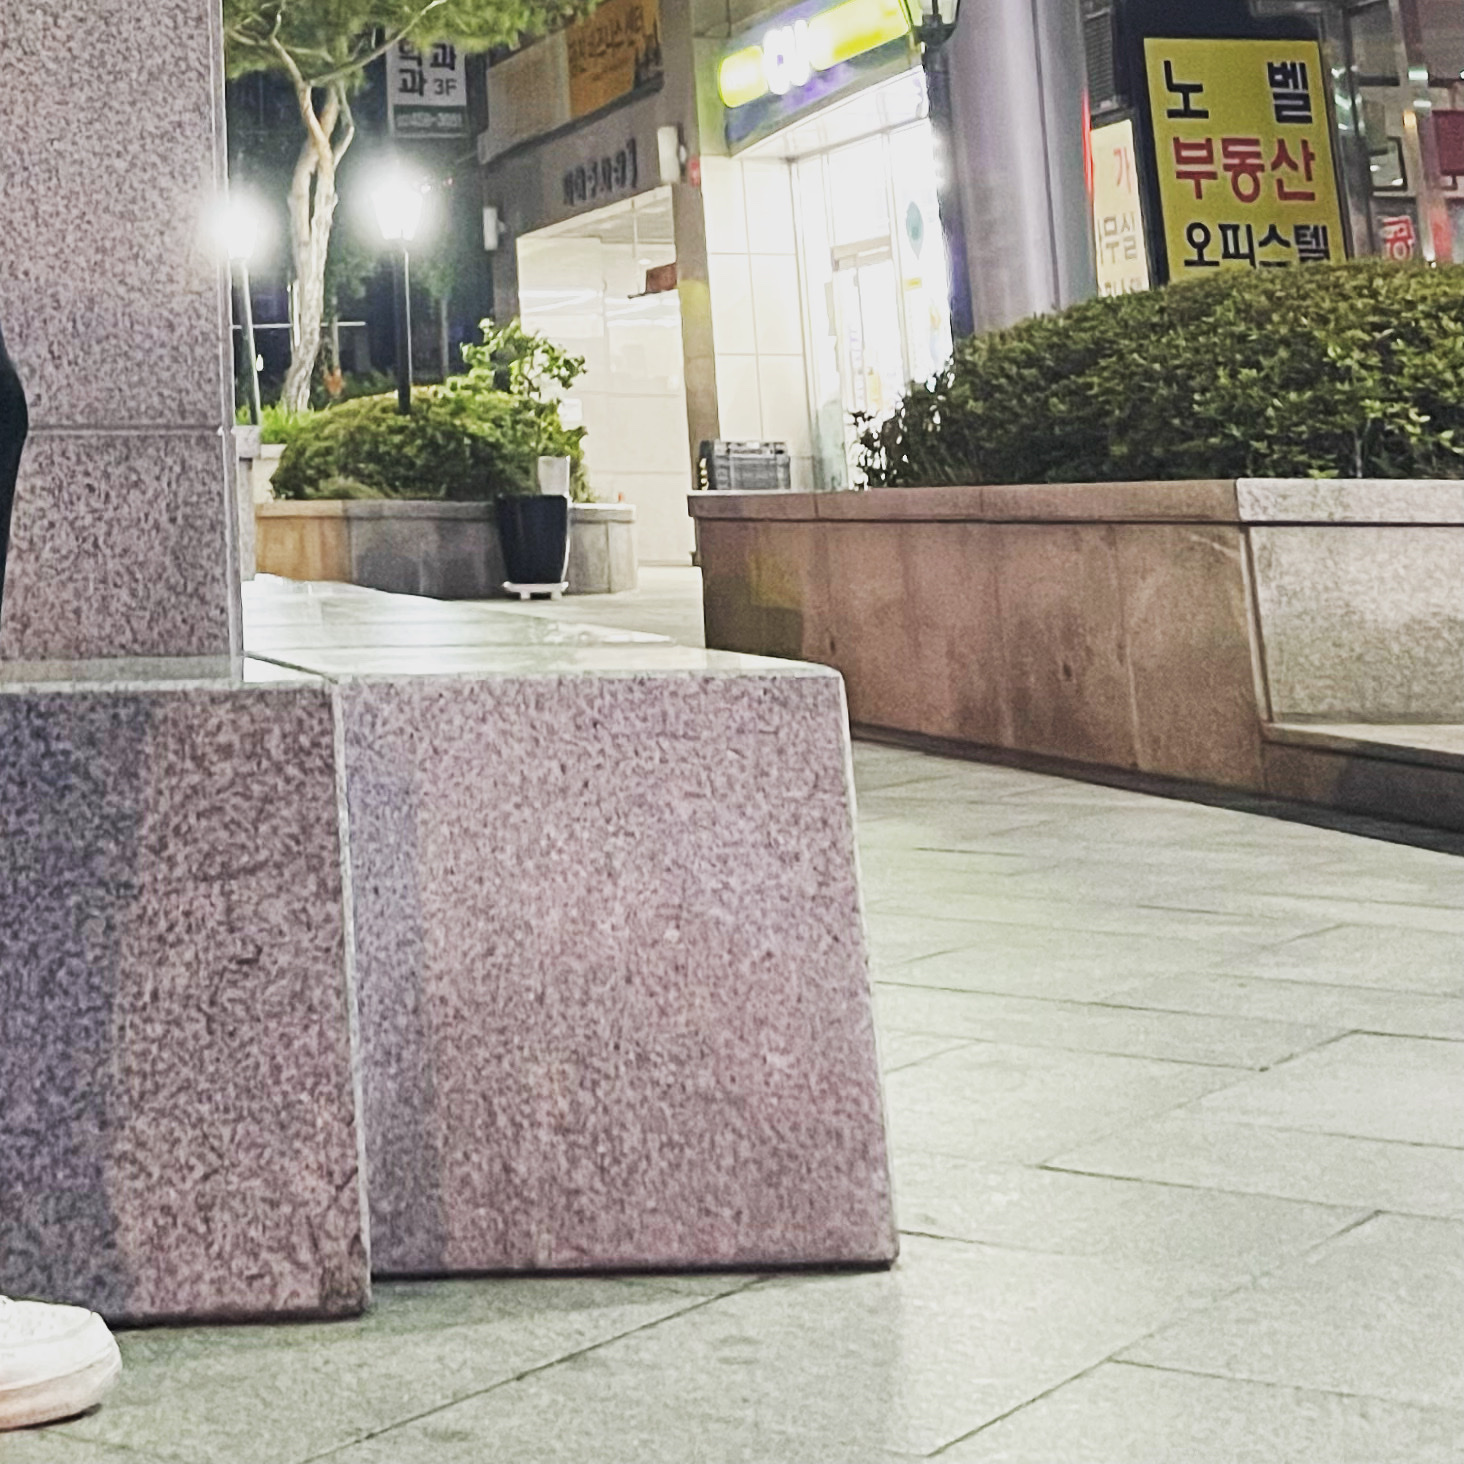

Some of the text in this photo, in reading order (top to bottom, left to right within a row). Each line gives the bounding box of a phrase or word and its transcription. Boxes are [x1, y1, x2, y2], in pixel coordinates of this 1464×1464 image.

[433, 77, 458, 96] 3F
[1163, 59, 1314, 125] 노 벨
[1173, 136, 1316, 204] 부동산
[1184, 222, 1330, 269] 오피스텔
